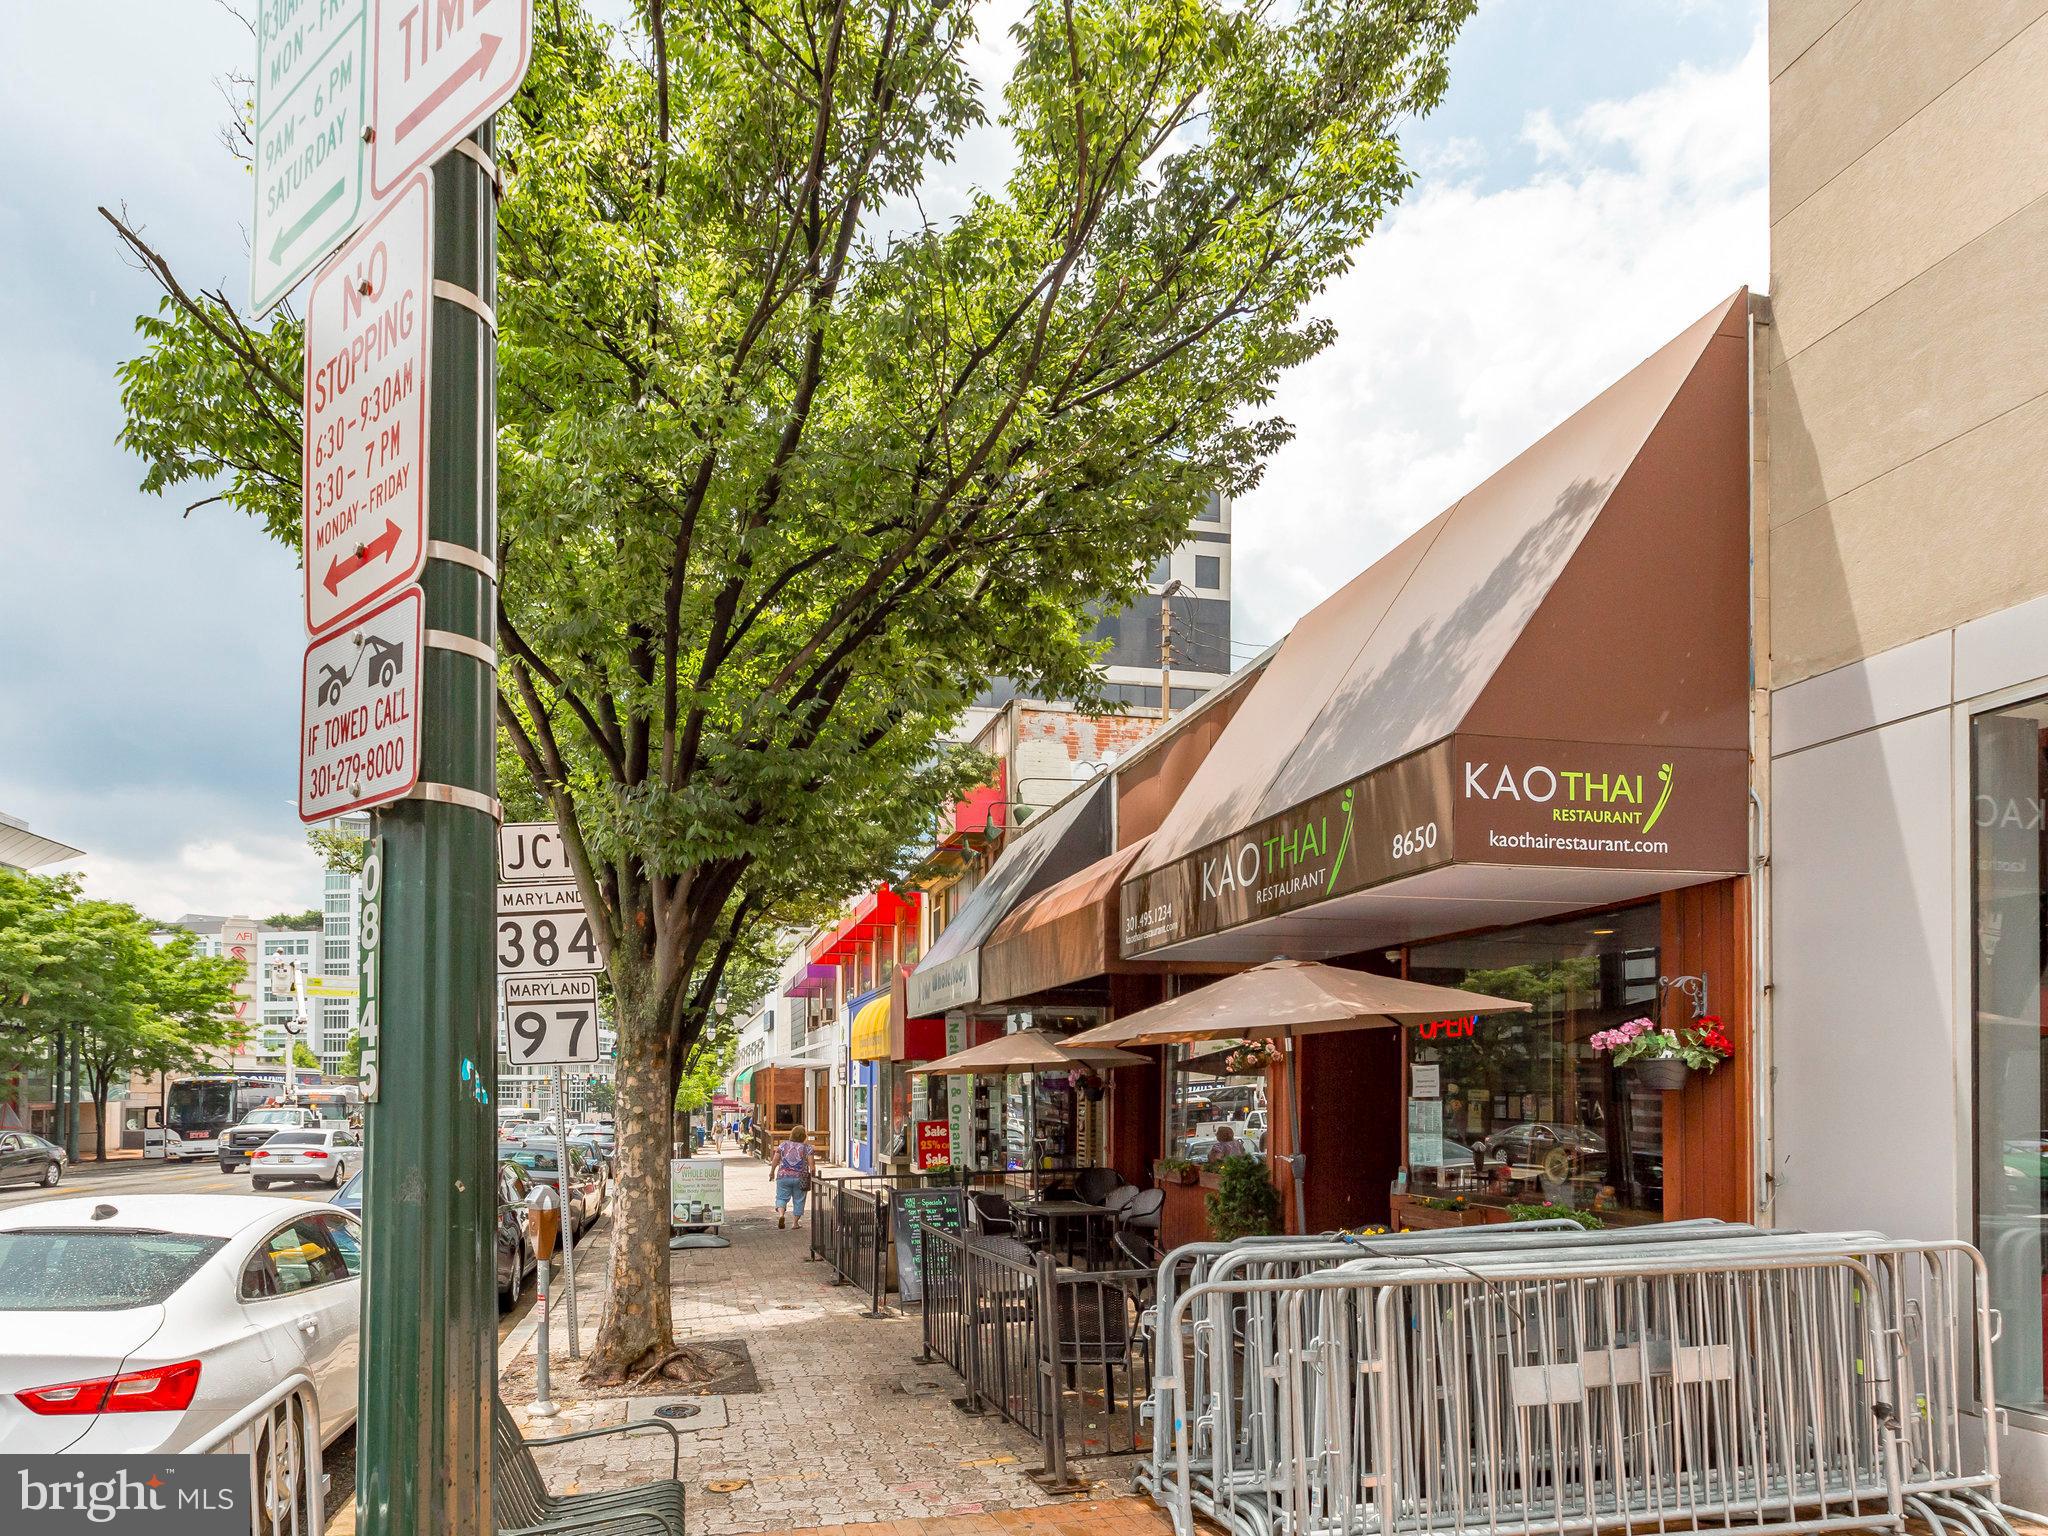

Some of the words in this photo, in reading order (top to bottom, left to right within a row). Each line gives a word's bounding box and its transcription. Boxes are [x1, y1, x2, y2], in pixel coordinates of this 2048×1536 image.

[270, 25, 304, 91] MON
[319, 0, 345, 32] FR
[399, 0, 493, 83] TIM
[265, 115, 294, 172] 9AM
[314, 83, 323, 118] 6
[329, 50, 353, 104] PM
[267, 107, 347, 218] SATURDAY
[343, 240, 388, 332] NO
[314, 288, 414, 414] STOPPING
[315, 415, 344, 469] 6:30
[360, 357, 413, 431] 9:30AM
[315, 465, 344, 517] 3:30
[365, 438, 374, 480] 7
[381, 419, 400, 468] PM
[316, 501, 358, 552] MONDAY
[369, 462, 409, 515] FRIDAY
[308, 723, 320, 757] IF
[324, 705, 368, 751] TOWED
[374, 687, 410, 731] CALL
[309, 736, 405, 800] 301-279-8000
[1552, 808, 1643, 825] RESTAURANT
[1391, 821, 1438, 860] 8650
[1488, 829, 1669, 854] kaothairestaurant.com
[502, 890, 583, 907] MARYLAND
[1255, 867, 1327, 905] RESTAURANT
[235, 932, 253, 941] AFI
[1125, 902, 1172, 933] 301.495.1234
[498, 917, 597, 968] 384
[509, 982, 591, 997] MARYLAND
[513, 1010, 590, 1059] 97
[1419, 1015, 1475, 1040] OPEN
[920, 1140, 941, 1150] 25%
[924, 1125, 948, 1137] Sale
[681, 1168, 703, 1178] WHOLE
[704, 1168, 721, 1178] BODY
[925, 1153, 949, 1165] Sale
